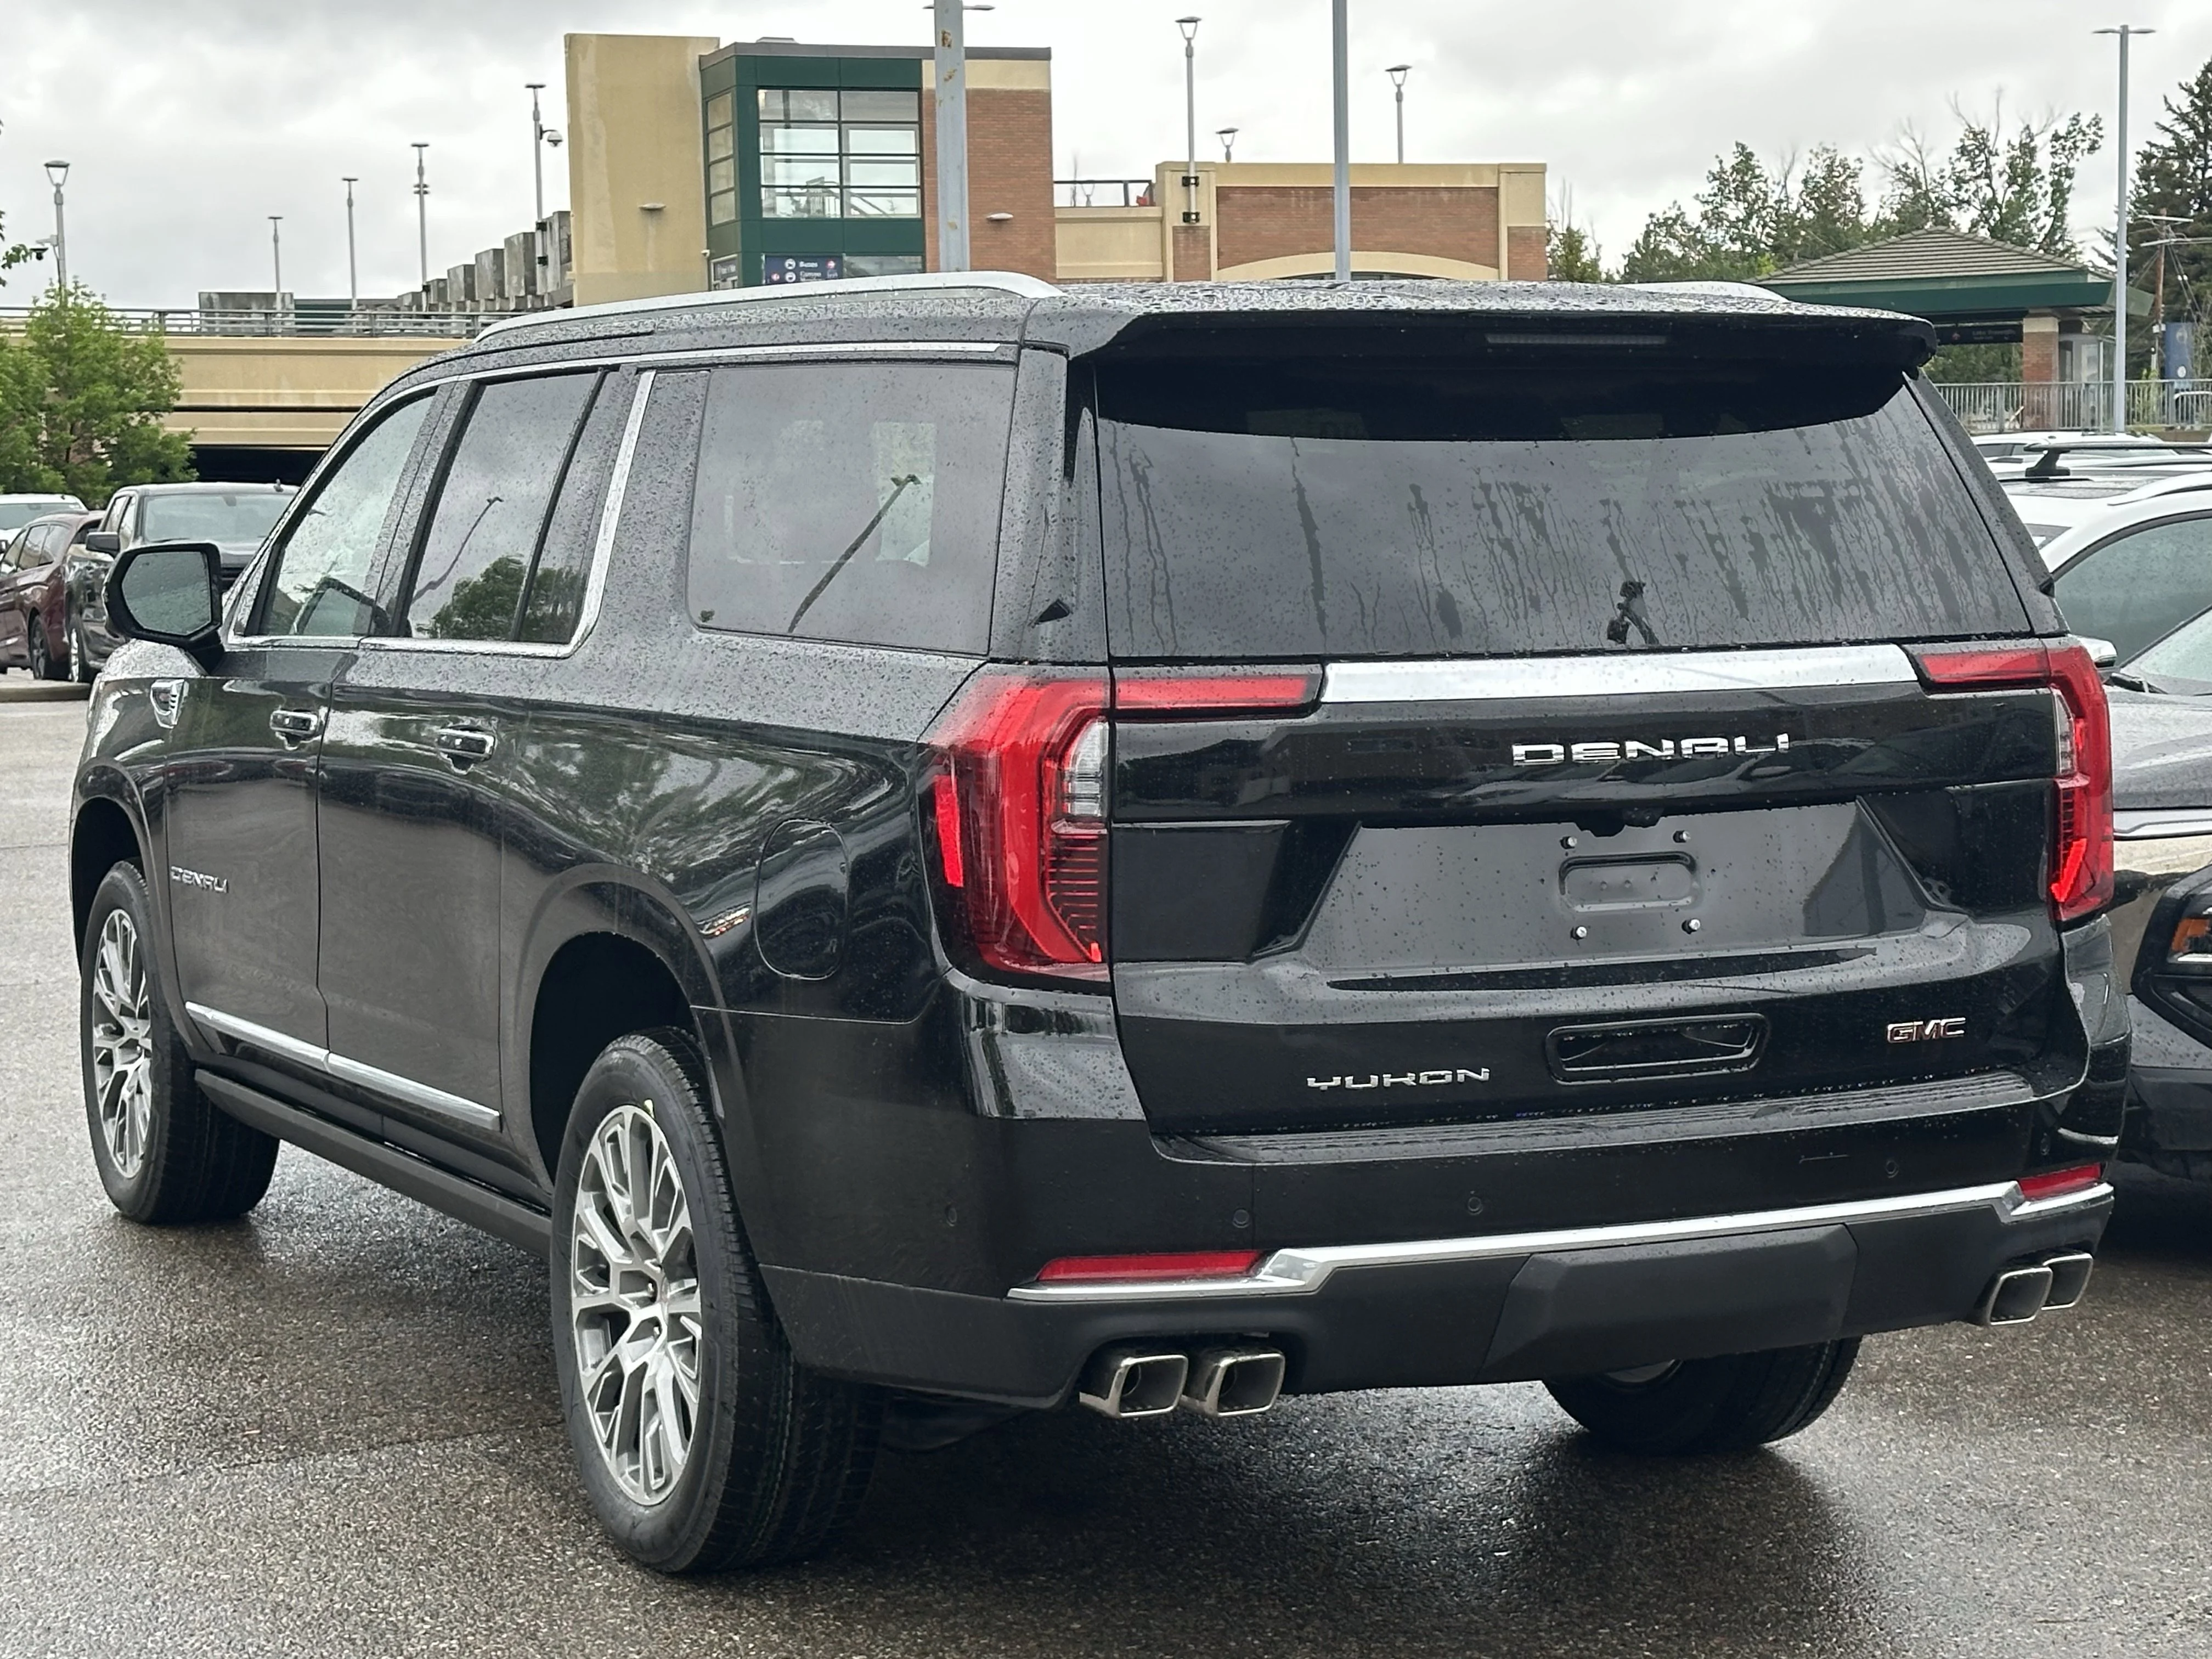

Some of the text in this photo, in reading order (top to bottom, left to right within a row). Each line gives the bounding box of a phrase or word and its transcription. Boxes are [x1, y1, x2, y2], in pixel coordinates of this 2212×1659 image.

[1512, 733, 1790, 766] DENALI
[171, 866, 227, 893] DENALI
[1887, 1017, 1966, 1043] GMC
[1307, 1068, 1490, 1091] YUKON
